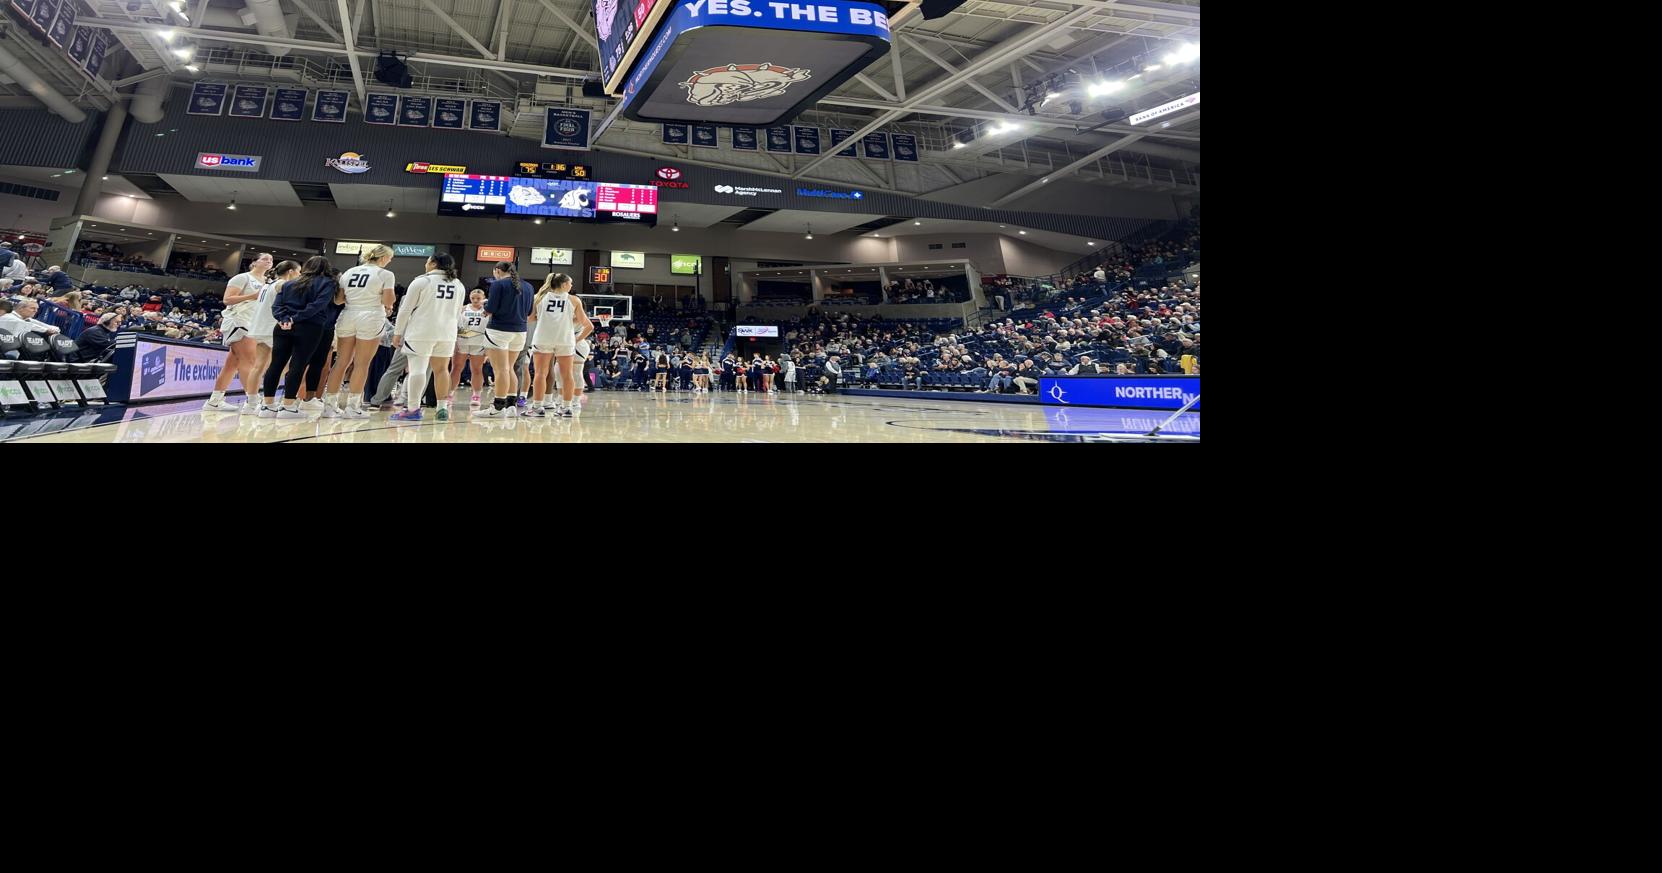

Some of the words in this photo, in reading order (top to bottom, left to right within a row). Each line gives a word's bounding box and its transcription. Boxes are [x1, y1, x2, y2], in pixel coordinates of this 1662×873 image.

[685, 0, 762, 17] YES.
[769, 1, 839, 23] THE
[220, 155, 256, 167] bank
[575, 169, 585, 177] 50
[347, 274, 370, 288] 20
[594, 273, 608, 282] 30
[436, 284, 455, 299] 55
[546, 300, 565, 313] 24
[468, 317, 481, 326] 23
[174, 357, 191, 381] The
